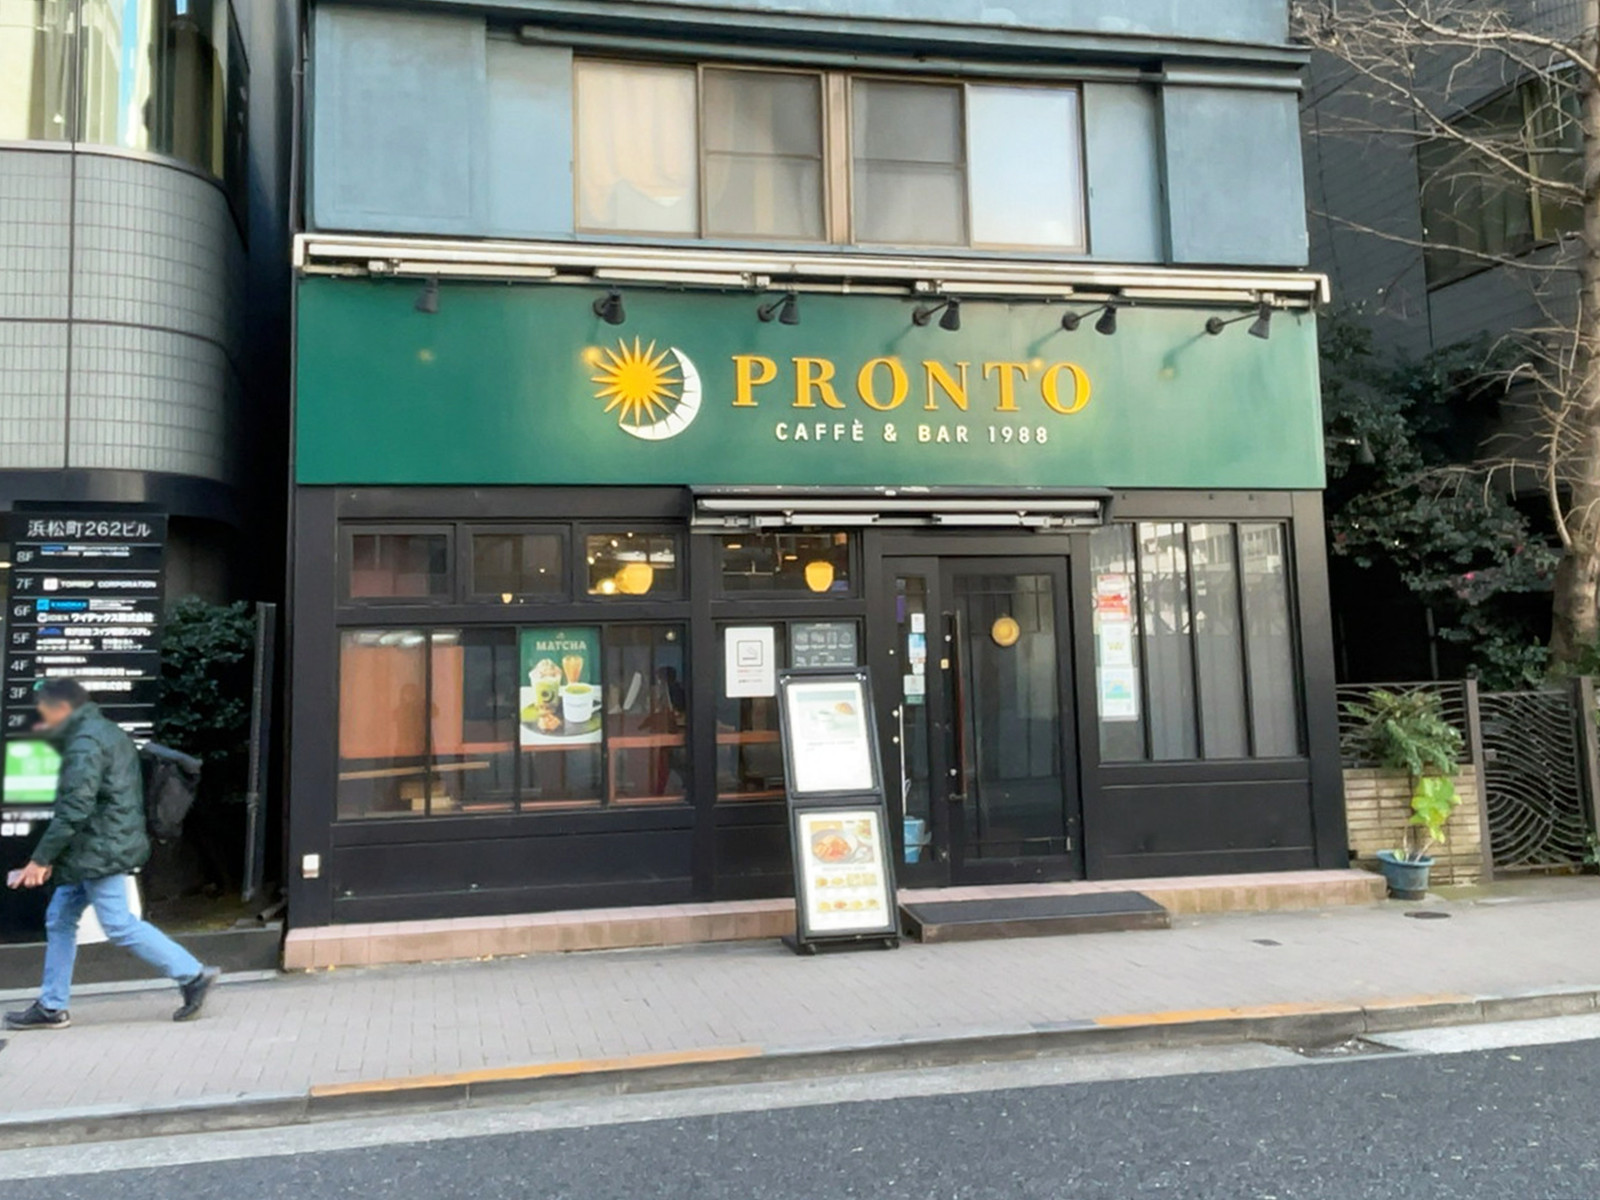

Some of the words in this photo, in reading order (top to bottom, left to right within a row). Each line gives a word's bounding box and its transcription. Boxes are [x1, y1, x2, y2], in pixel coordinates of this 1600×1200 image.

[732, 354, 1092, 415] PRONTO
[775, 418, 864, 441] CAFFÈ
[883, 423, 898, 442] &
[917, 425, 969, 443] BAR
[988, 426, 1048, 444] 1988
[27, 520, 152, 538] 浜松町262ビル
[16, 551, 34, 563] 8F
[16, 577, 34, 590] 7F
[13, 605, 32, 617] 6F
[12, 632, 30, 644] 5F
[536, 640, 587, 652] MATCHA
[10, 659, 29, 672] 4F
[9, 686, 28, 699] 3F
[7, 714, 26, 727] 2F
